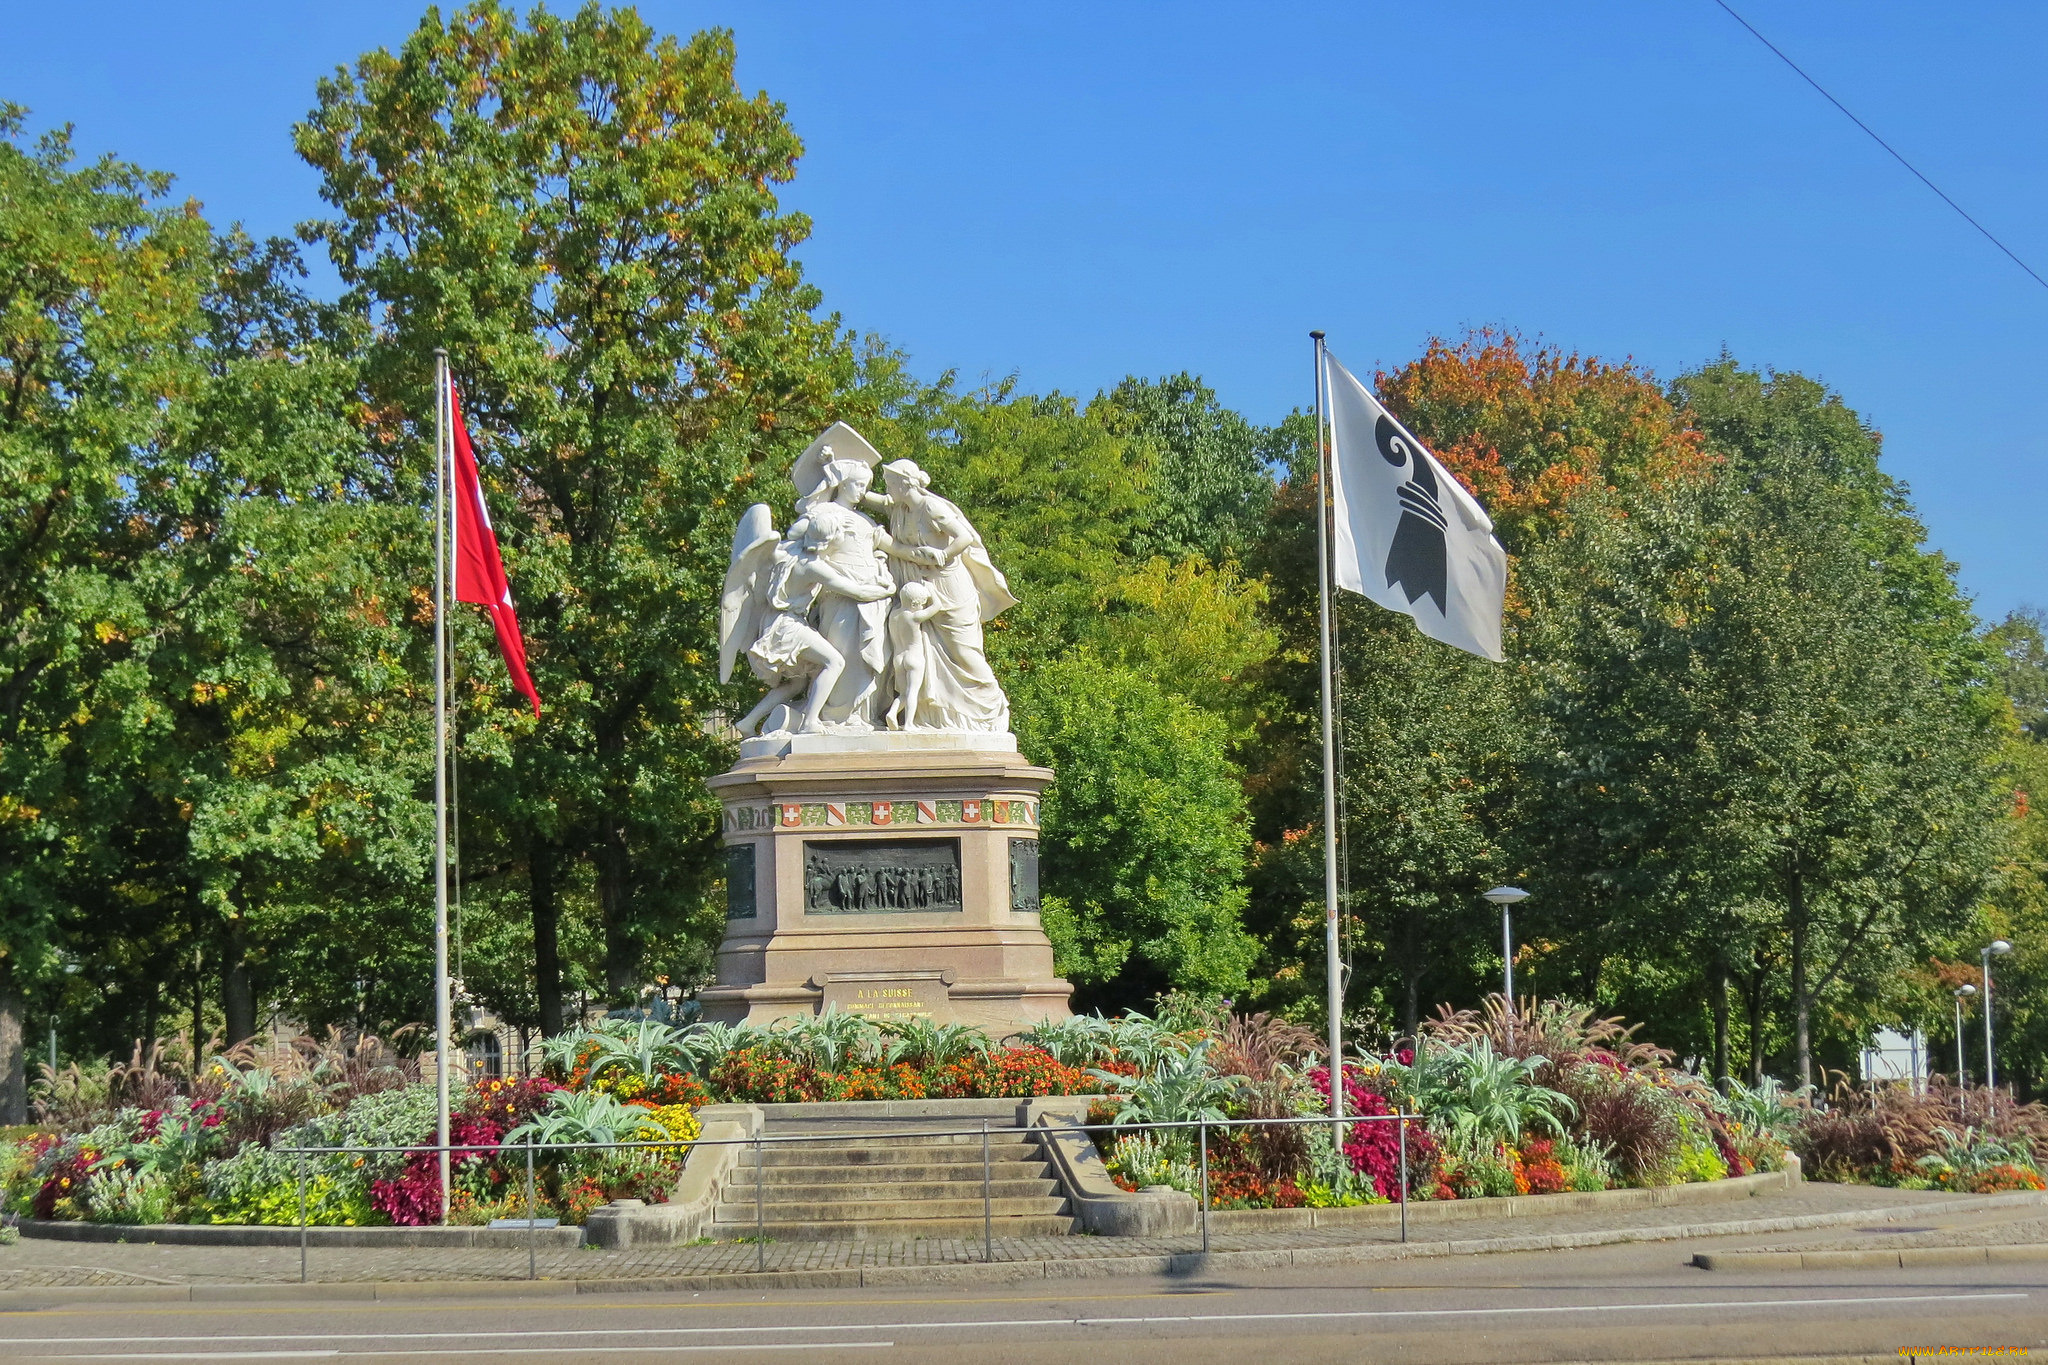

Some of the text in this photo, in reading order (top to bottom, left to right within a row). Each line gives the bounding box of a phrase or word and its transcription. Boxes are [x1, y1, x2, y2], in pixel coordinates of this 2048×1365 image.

[858, 988, 913, 998] A LA SUISSE
